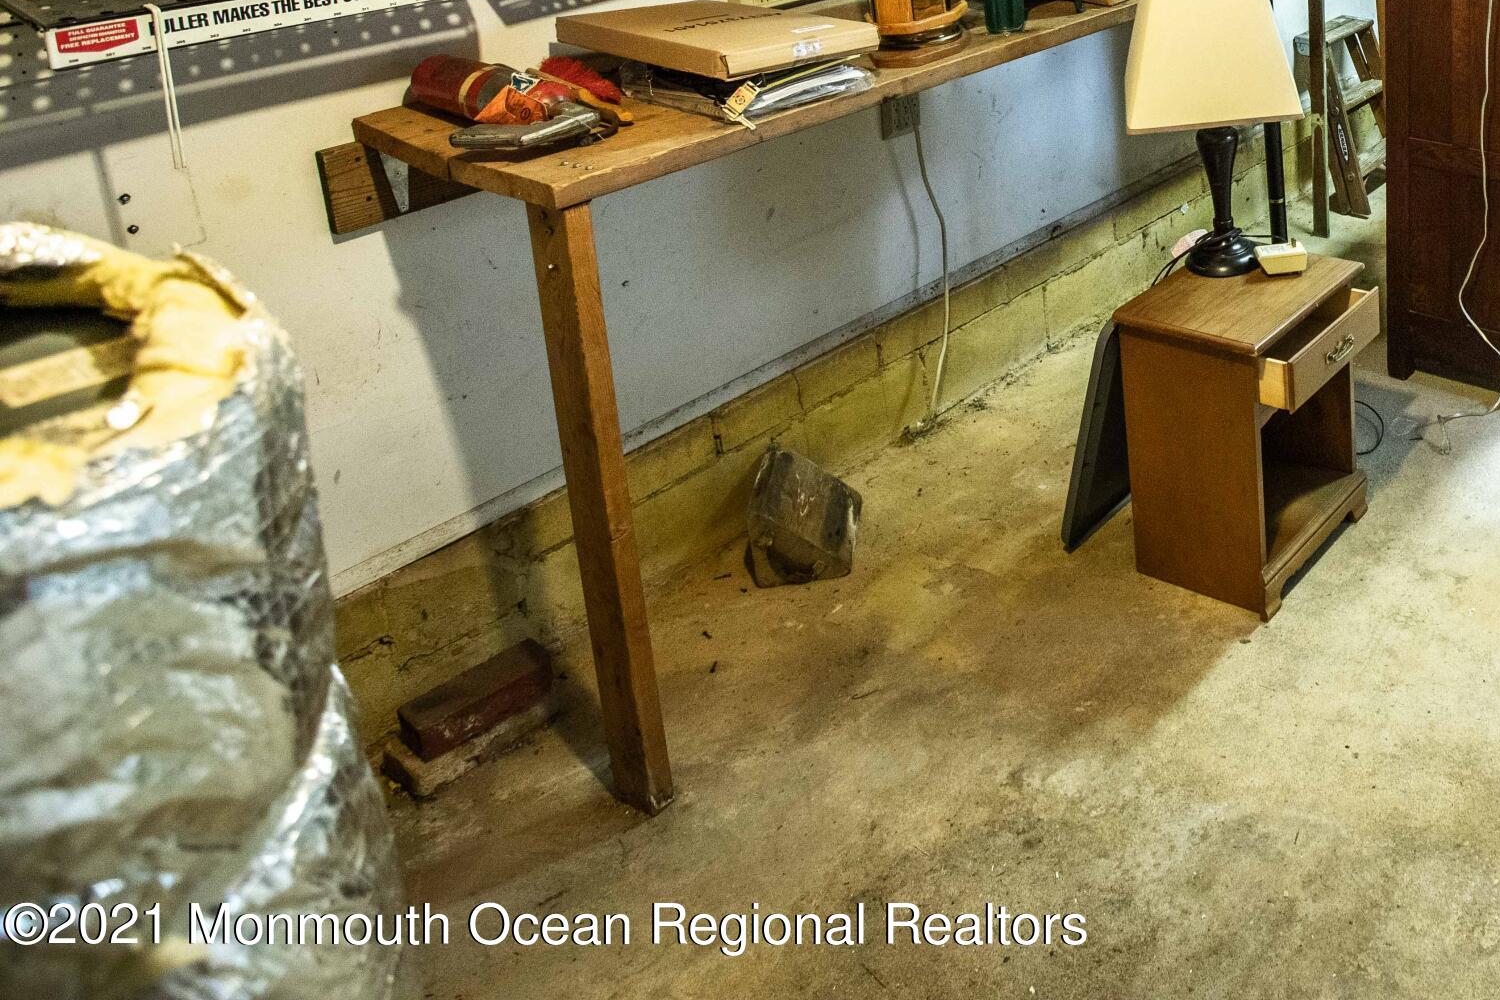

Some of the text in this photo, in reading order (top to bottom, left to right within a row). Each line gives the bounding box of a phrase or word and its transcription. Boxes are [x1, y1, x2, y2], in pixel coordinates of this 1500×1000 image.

[213, 3, 270, 25] MAKES
[67, 22, 126, 37] FULL GUARANTEE
[60, 32, 135, 50] FREE REPLACEMENT
